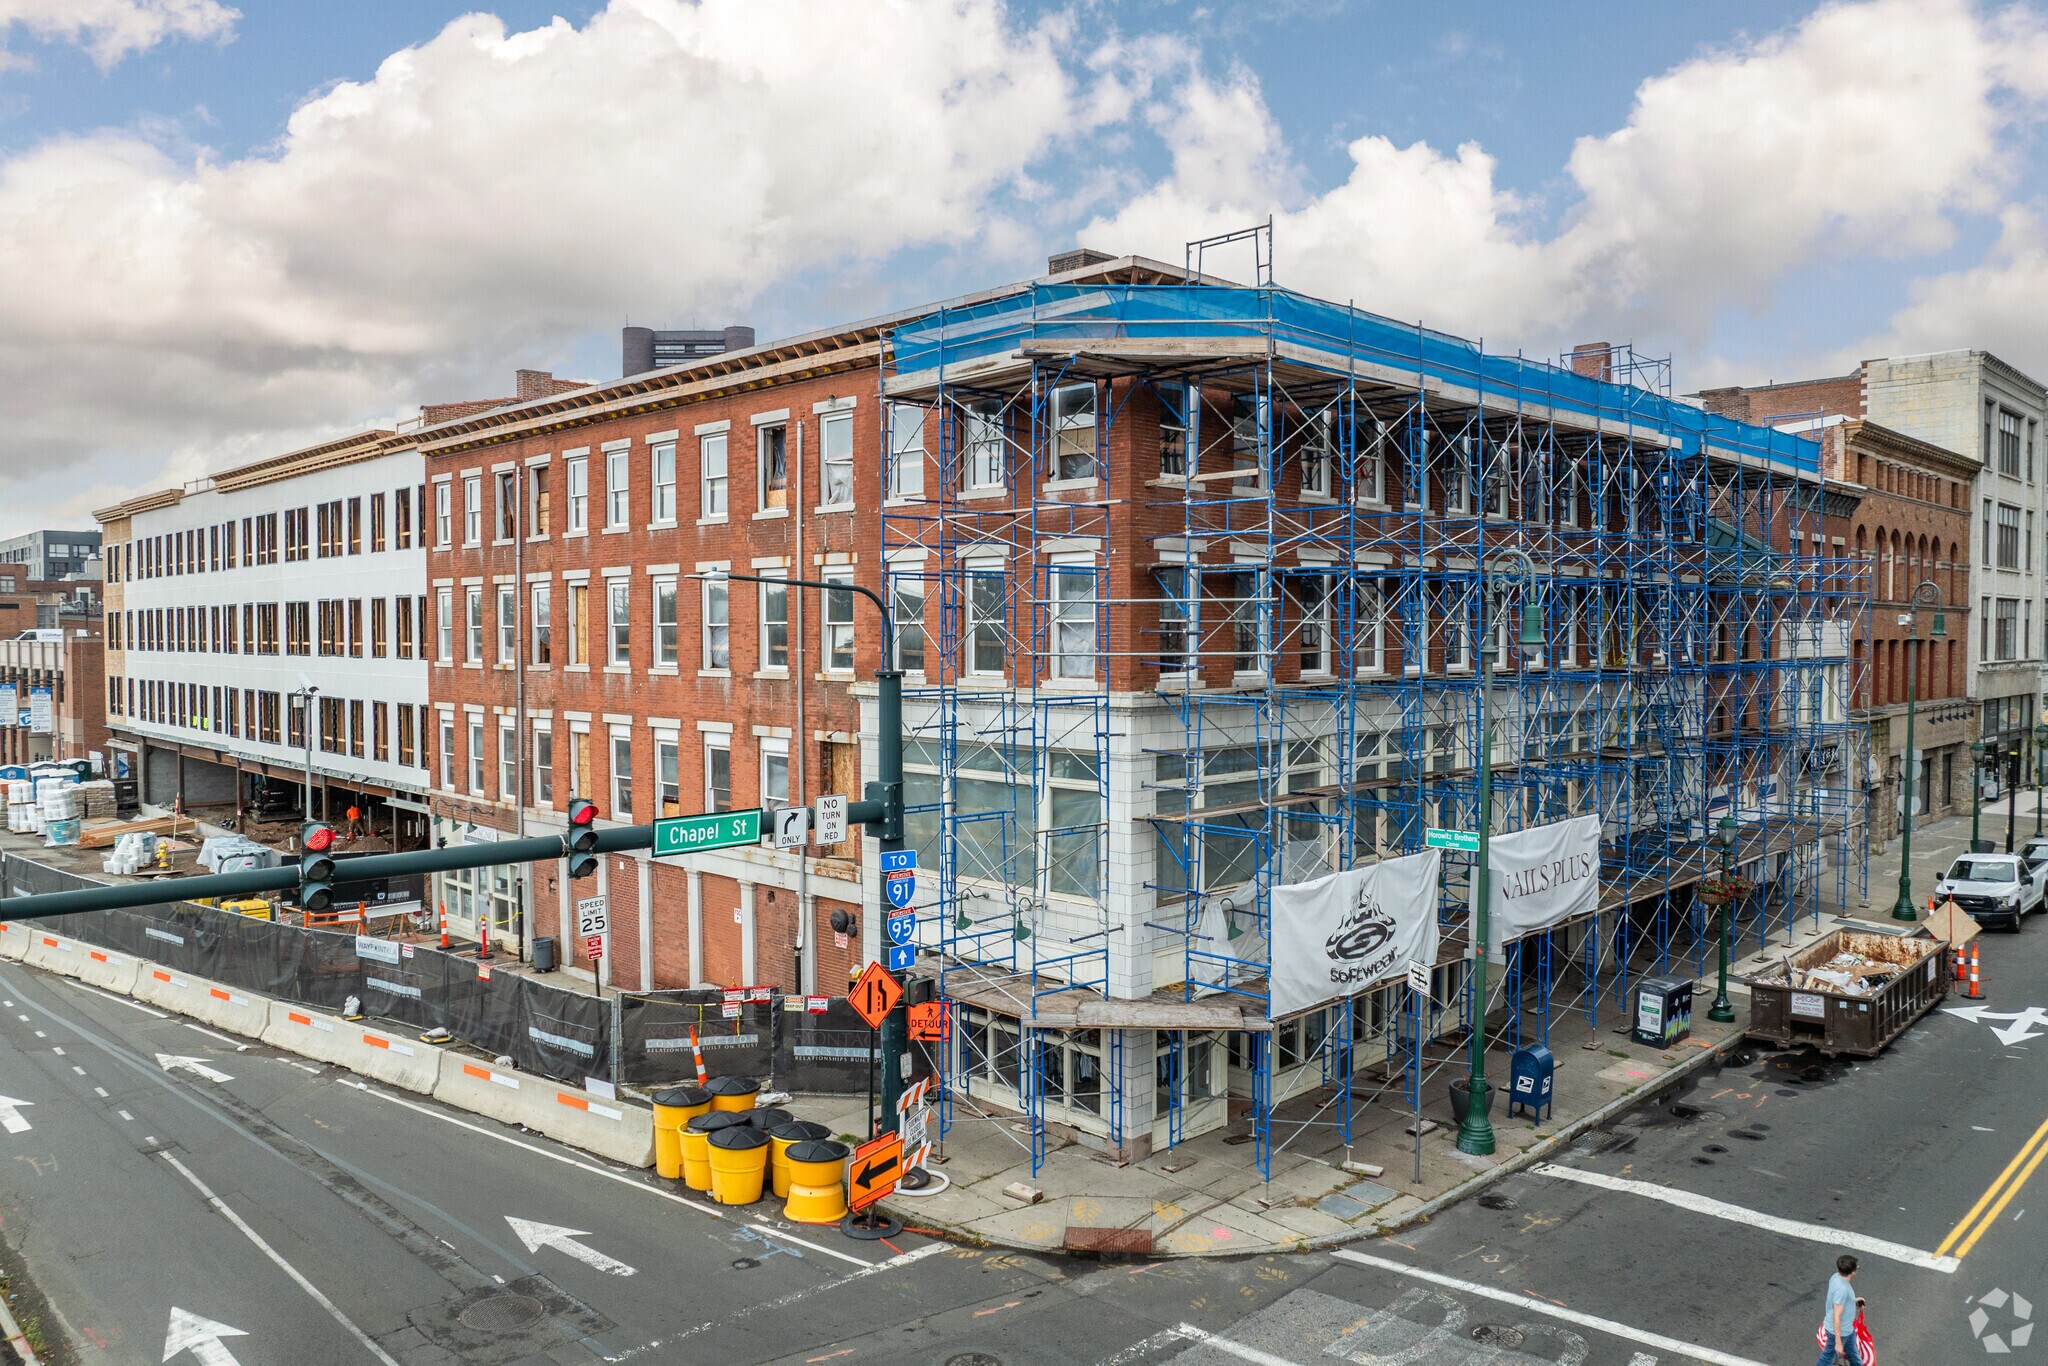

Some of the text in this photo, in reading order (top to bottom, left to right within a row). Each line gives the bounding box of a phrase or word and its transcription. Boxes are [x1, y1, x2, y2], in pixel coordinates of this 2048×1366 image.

[823, 799, 838, 810] NO
[822, 811, 841, 820] TURN
[826, 821, 837, 830] ON
[670, 819, 747, 844] Chapel St
[824, 832, 839, 840] RED
[1428, 831, 1478, 843] Horowitz Brothers
[781, 835, 800, 845] ONLY
[890, 855, 907, 867] TO
[1502, 852, 1590, 900] NAILS PLUS
[893, 883, 908, 901] 91
[580, 900, 605, 910] SPEED
[583, 908, 602, 917] LIMIT
[891, 909, 912, 918] INTERSTATE
[581, 915, 605, 932] 25
[892, 919, 912, 938] 95
[911, 1019, 949, 1028] DETOUR
[646, 1035, 758, 1048] CONSTUCTION
[795, 1047, 881, 1058] CONSTRUCT
[909, 1121, 921, 1136] CLOSED
